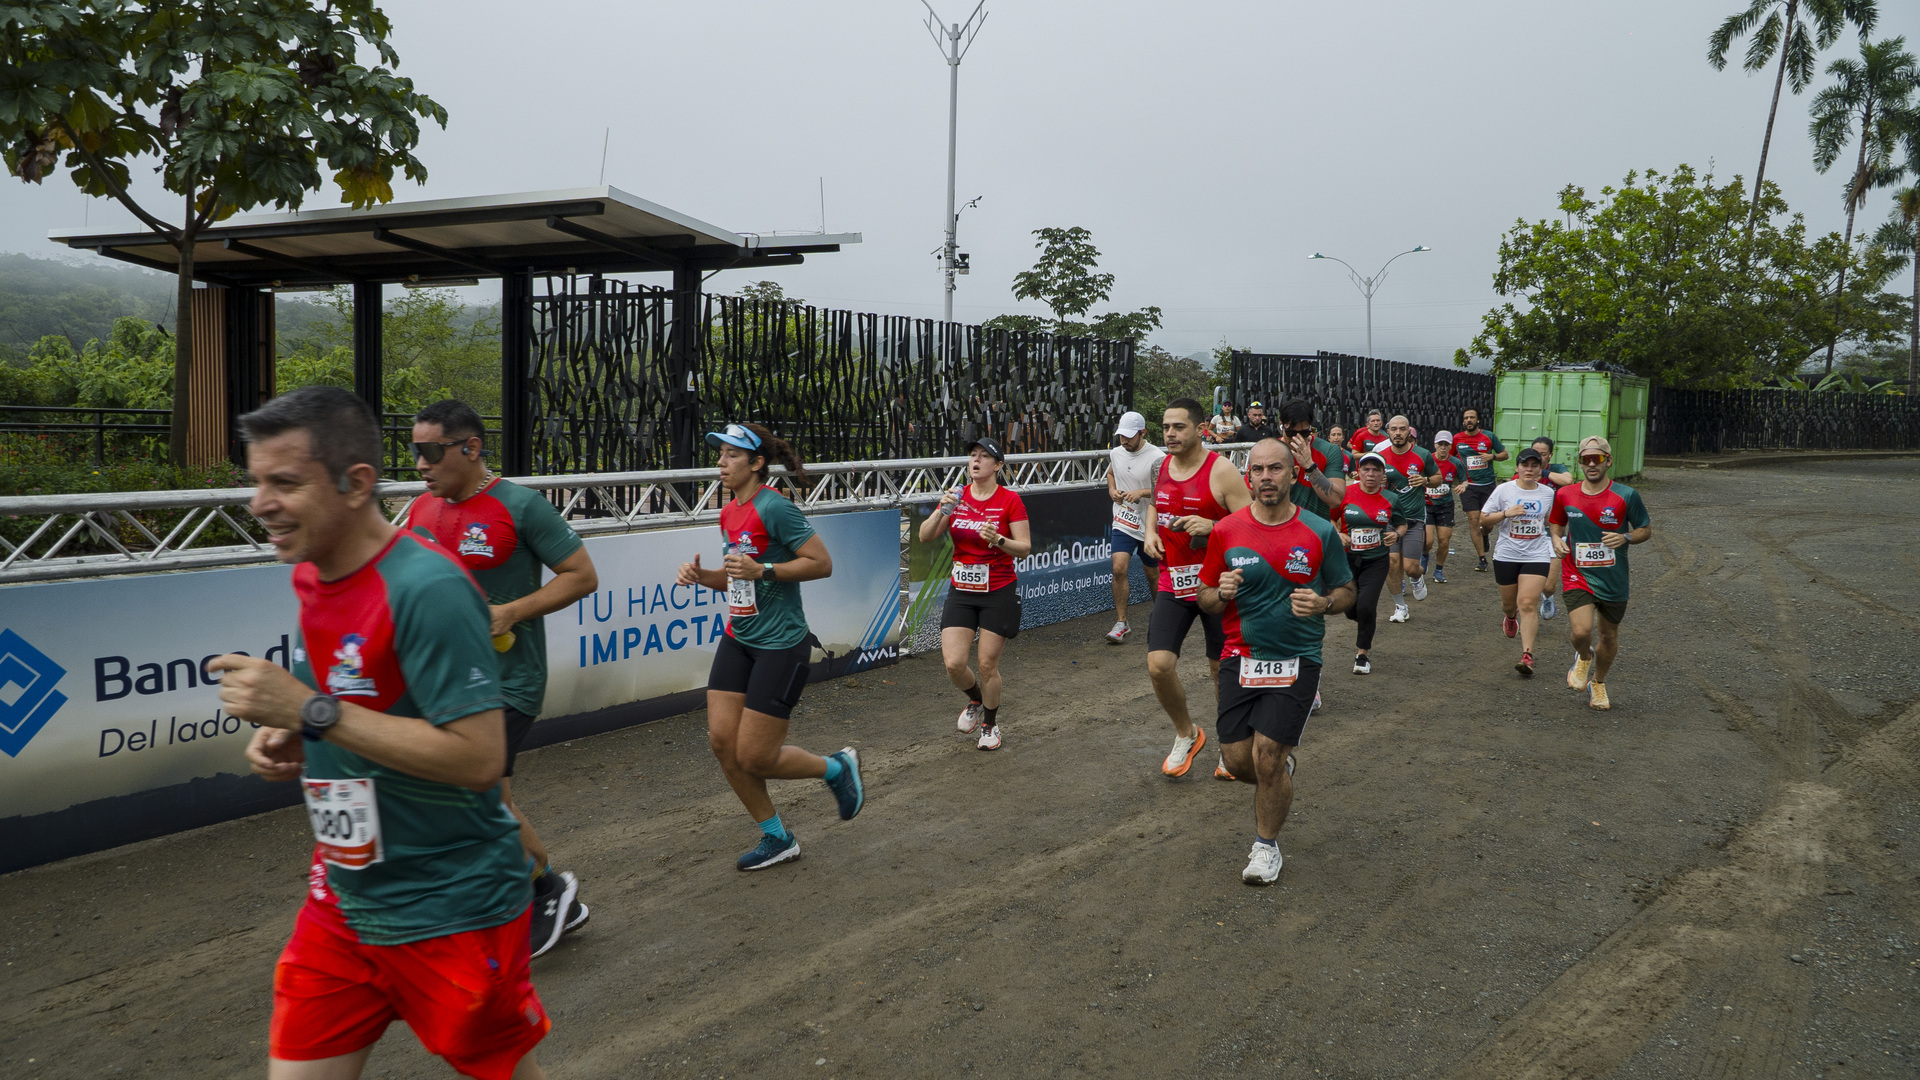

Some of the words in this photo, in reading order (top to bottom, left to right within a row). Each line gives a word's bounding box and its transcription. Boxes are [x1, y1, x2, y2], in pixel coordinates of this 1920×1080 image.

[1120, 510, 1138, 523] 1628
[1514, 525, 1537, 534] 1128
[1356, 534, 1376, 544] 1687
[1053, 544, 1069, 567] de
[1585, 550, 1605, 560] 489
[955, 570, 981, 583] 1855
[1171, 574, 1199, 588] 1857
[1025, 581, 1046, 599] lado
[1047, 579, 1059, 595] de
[1060, 577, 1074, 592] los
[1075, 577, 1091, 592] que
[578, 590, 613, 626] TU
[580, 613, 725, 668] IMPACTA
[857, 646, 897, 665] AVAL
[1253, 661, 1283, 675] 418
[94, 651, 250, 702] Banc
[99, 719, 158, 758] Del
[168, 708, 241, 746] lado
